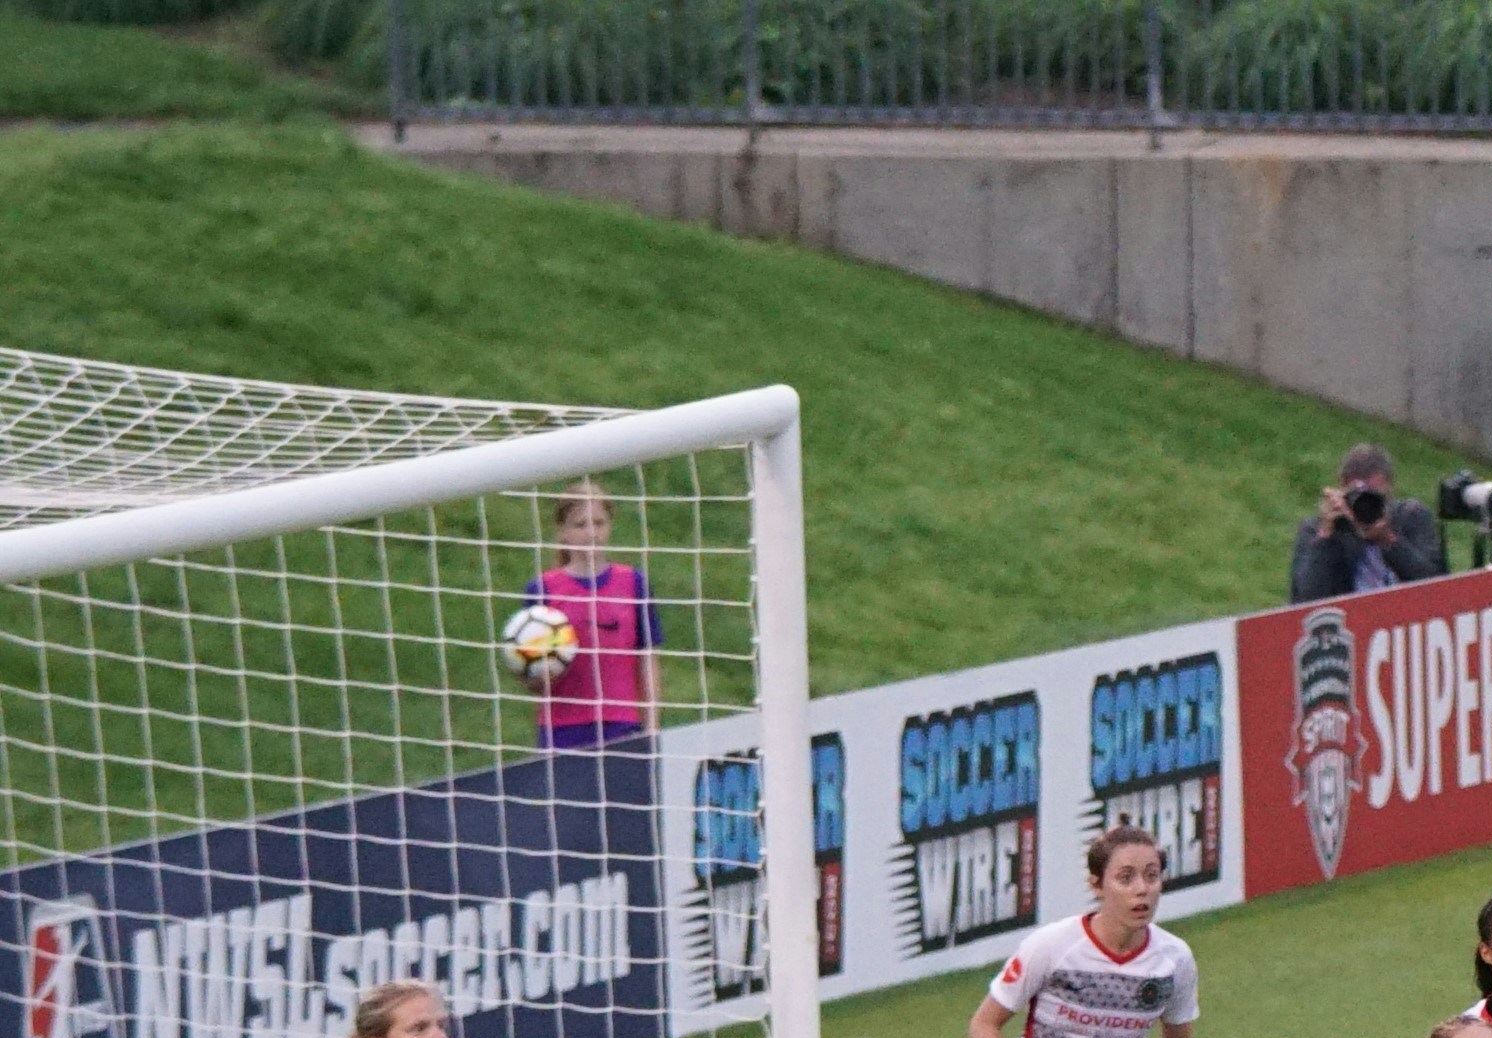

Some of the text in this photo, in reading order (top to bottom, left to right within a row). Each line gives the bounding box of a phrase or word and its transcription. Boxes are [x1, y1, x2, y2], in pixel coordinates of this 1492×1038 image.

[900, 691, 1040, 839] SOCCER
[1091, 652, 1222, 796] SOCCER
[916, 817, 1020, 944] WIRE
[1057, 1005, 1150, 1030] PROVIDEN
